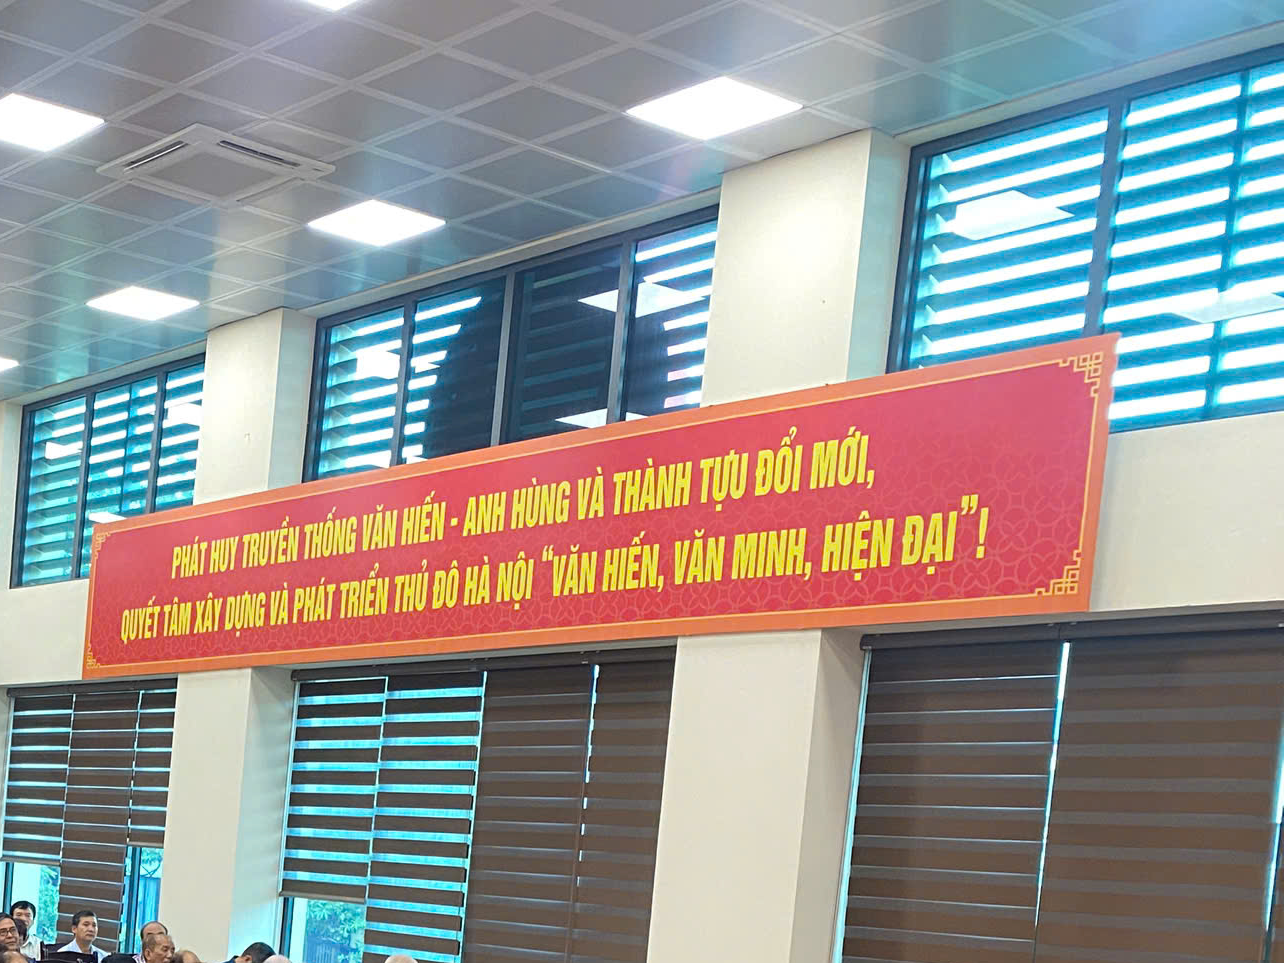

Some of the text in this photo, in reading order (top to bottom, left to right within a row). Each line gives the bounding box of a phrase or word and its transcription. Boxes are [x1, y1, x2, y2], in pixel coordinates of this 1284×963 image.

[120, 493, 989, 645] QUYẾT TÂM XÂY DỰNG VÀ PHÁT TRIỂN THỦ ĐÔ HÀ NỘI “VĂN HIẾN, VĂN MINH, HIỆN ĐẠI”!
[171, 425, 876, 580] PHÁT HUY TRUYỀN THỐNG VĂN HIẾN - ANH HÙNG VÀ THÀNH TỰU ĐỔI MỚI,
